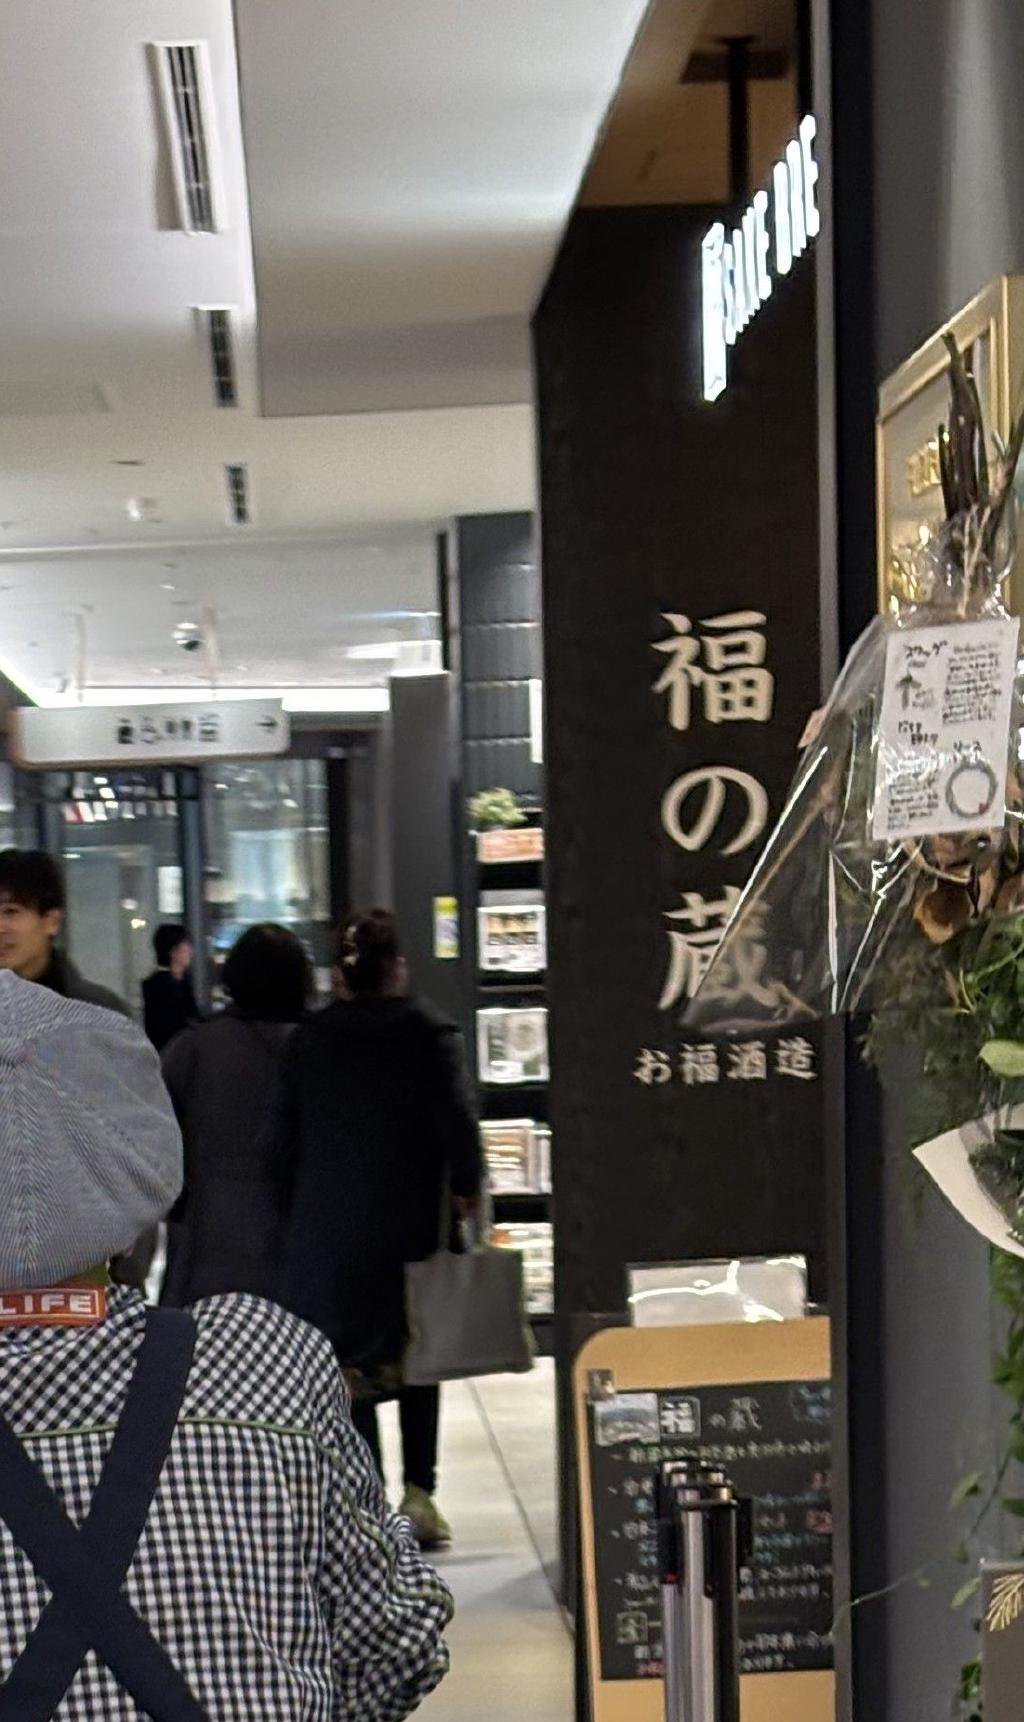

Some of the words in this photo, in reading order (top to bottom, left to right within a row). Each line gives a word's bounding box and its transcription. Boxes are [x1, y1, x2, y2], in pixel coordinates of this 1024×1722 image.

[650, 609, 777, 1011] 福の蔵
[633, 1035, 817, 1085] お福酒造
